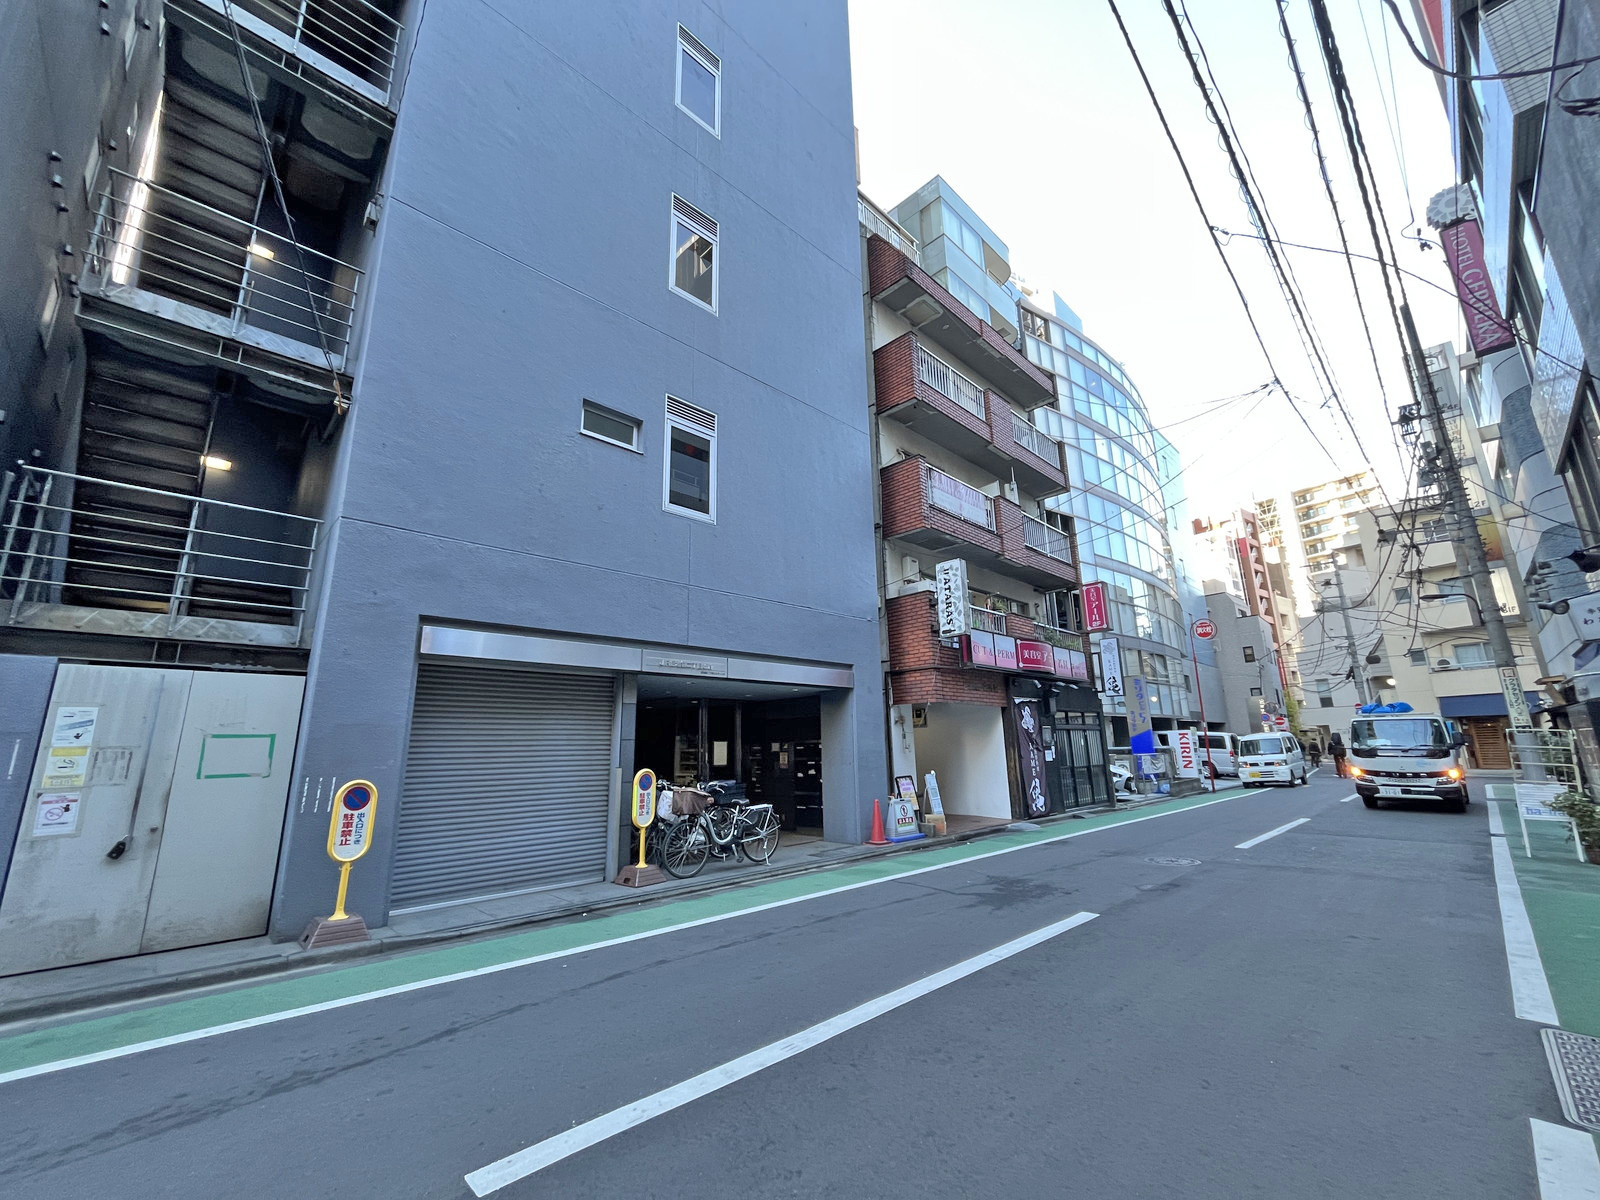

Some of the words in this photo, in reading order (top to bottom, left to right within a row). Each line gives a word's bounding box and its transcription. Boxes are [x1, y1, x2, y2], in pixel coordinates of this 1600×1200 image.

[1449, 226, 1475, 271] HOTEL
[1461, 267, 1502, 347] GERBERA
[973, 644, 987, 656] CUT
[988, 649, 994, 657] &
[997, 649, 1015, 660] PERM
[1178, 732, 1194, 769] KIRIN
[339, 812, 355, 846] 駐車禁止
[354, 812, 365, 845] 出入口につき
